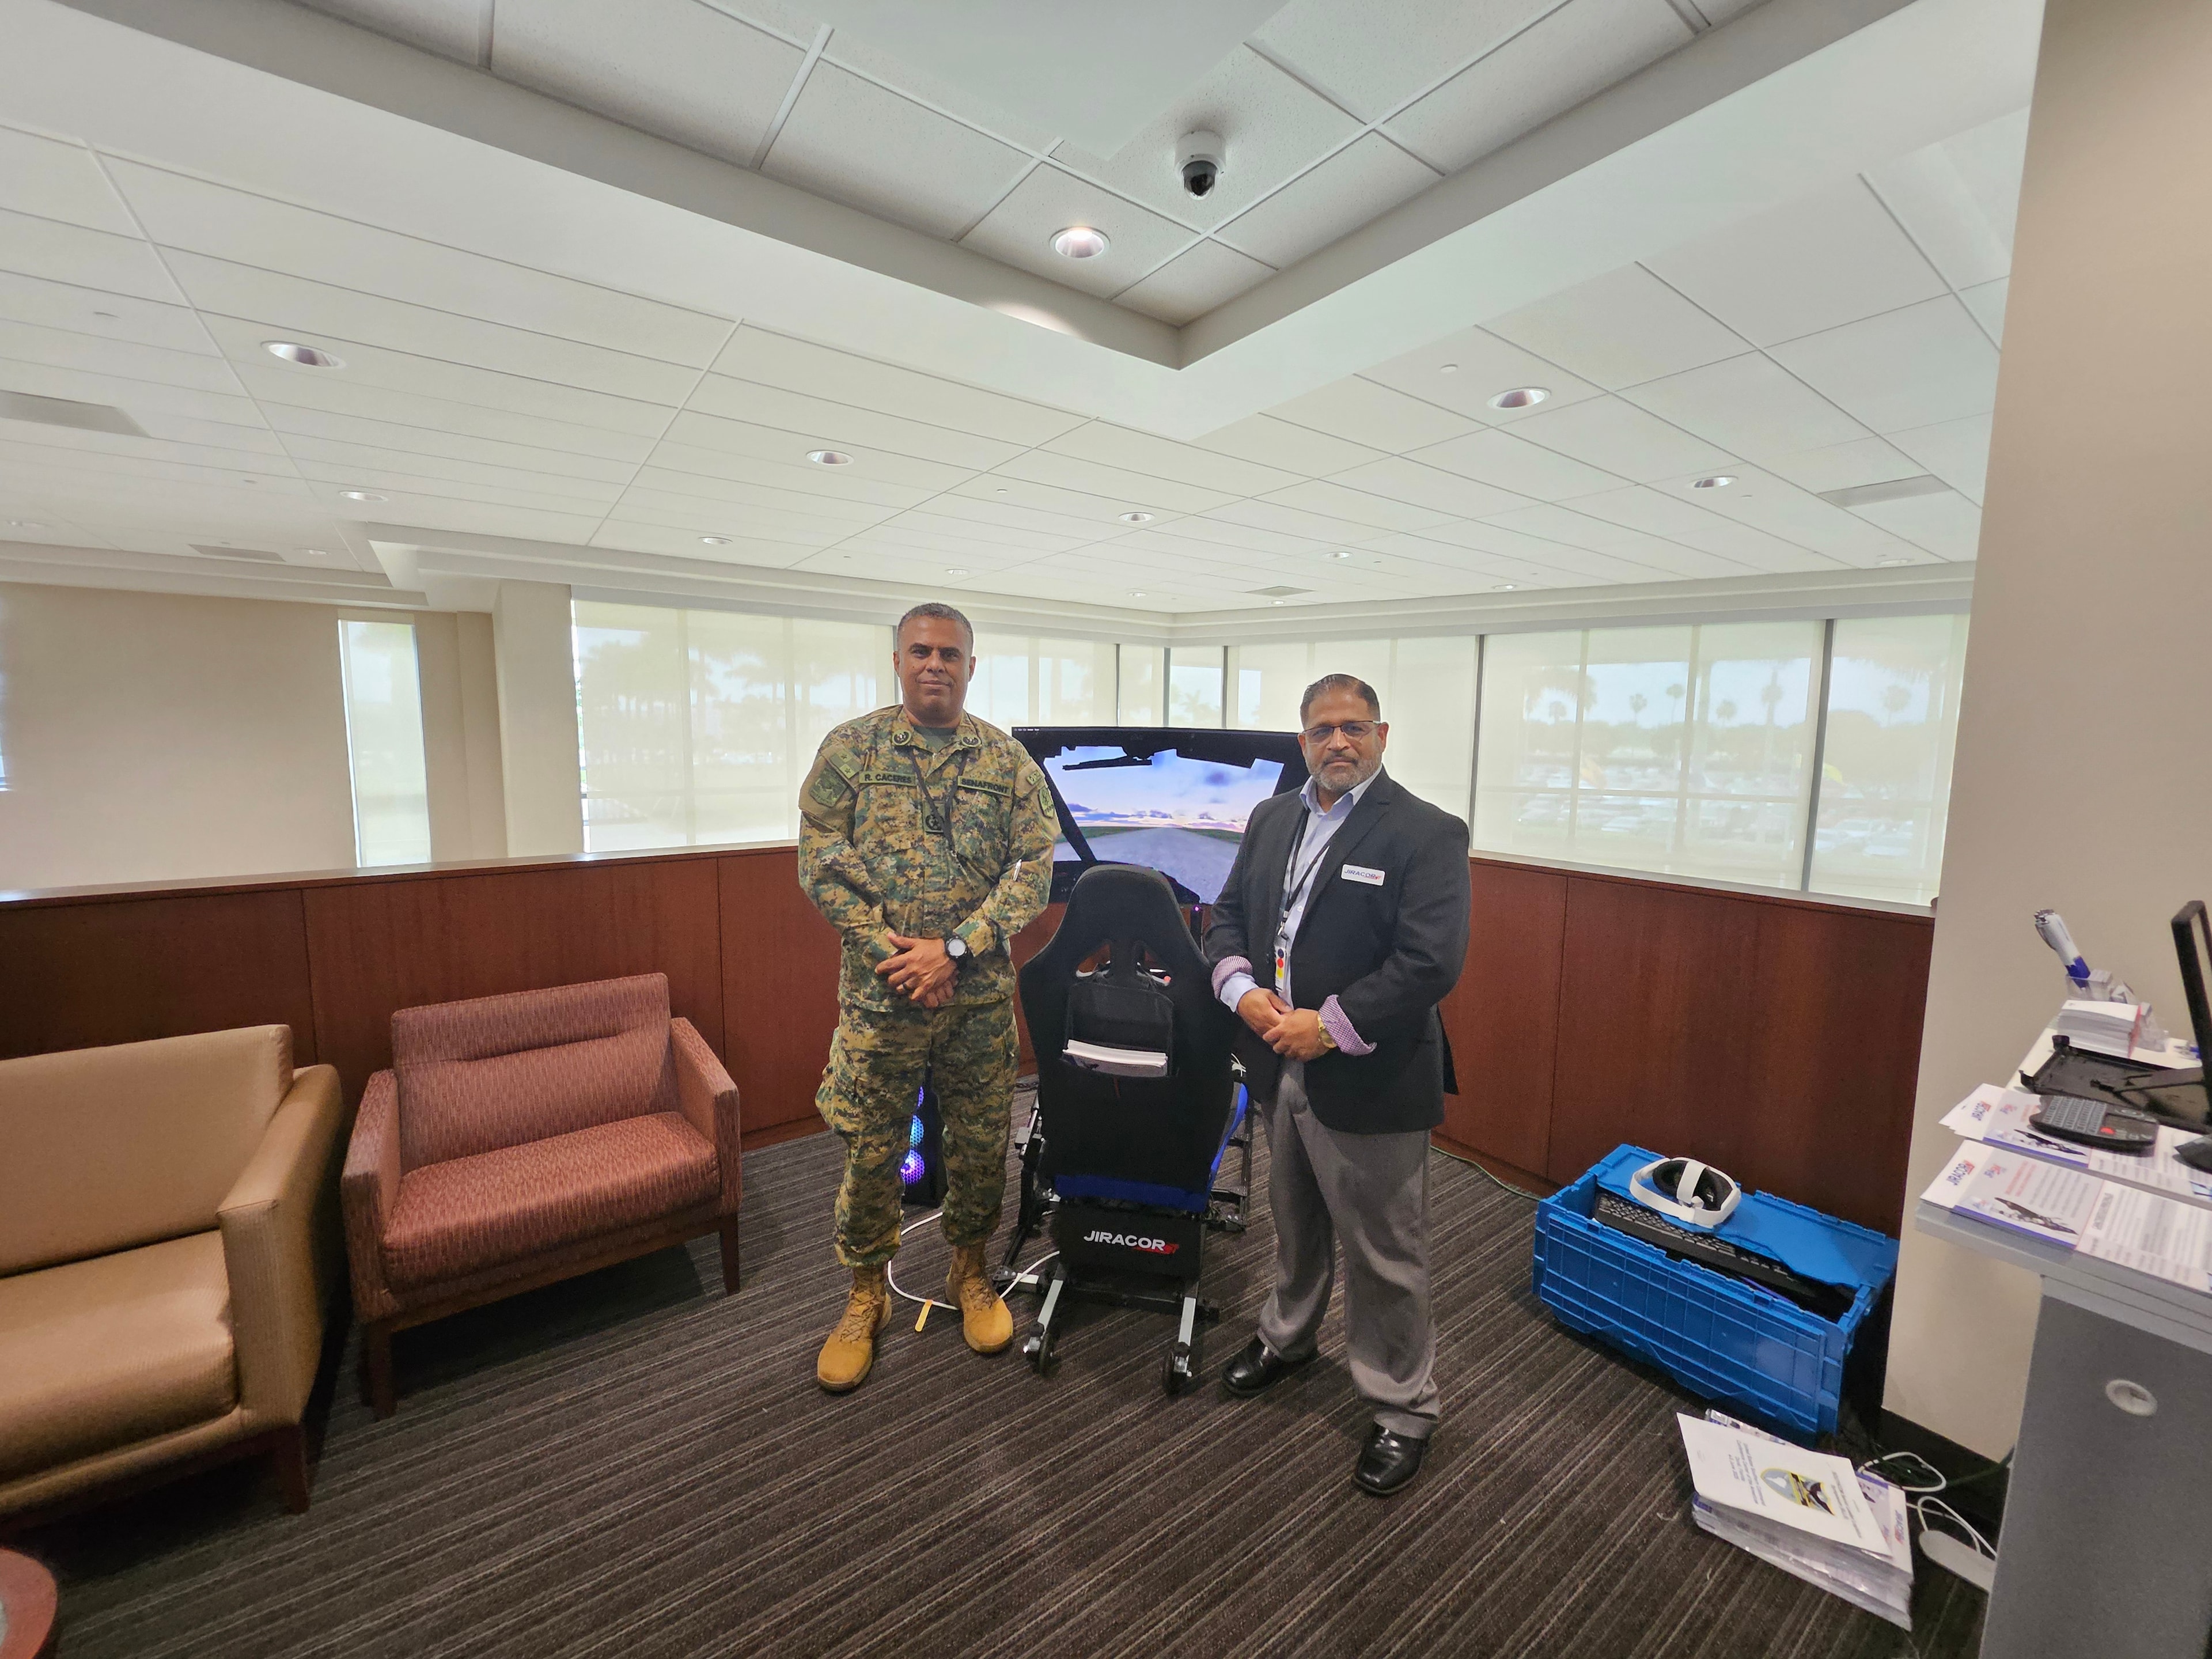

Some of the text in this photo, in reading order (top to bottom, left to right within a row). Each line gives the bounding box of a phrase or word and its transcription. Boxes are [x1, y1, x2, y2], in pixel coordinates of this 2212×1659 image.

[961, 778, 1009, 793] SENAFRONT
[1344, 869, 1376, 878] JIRACOR
[1083, 1230, 1166, 1251] JIRACOR
